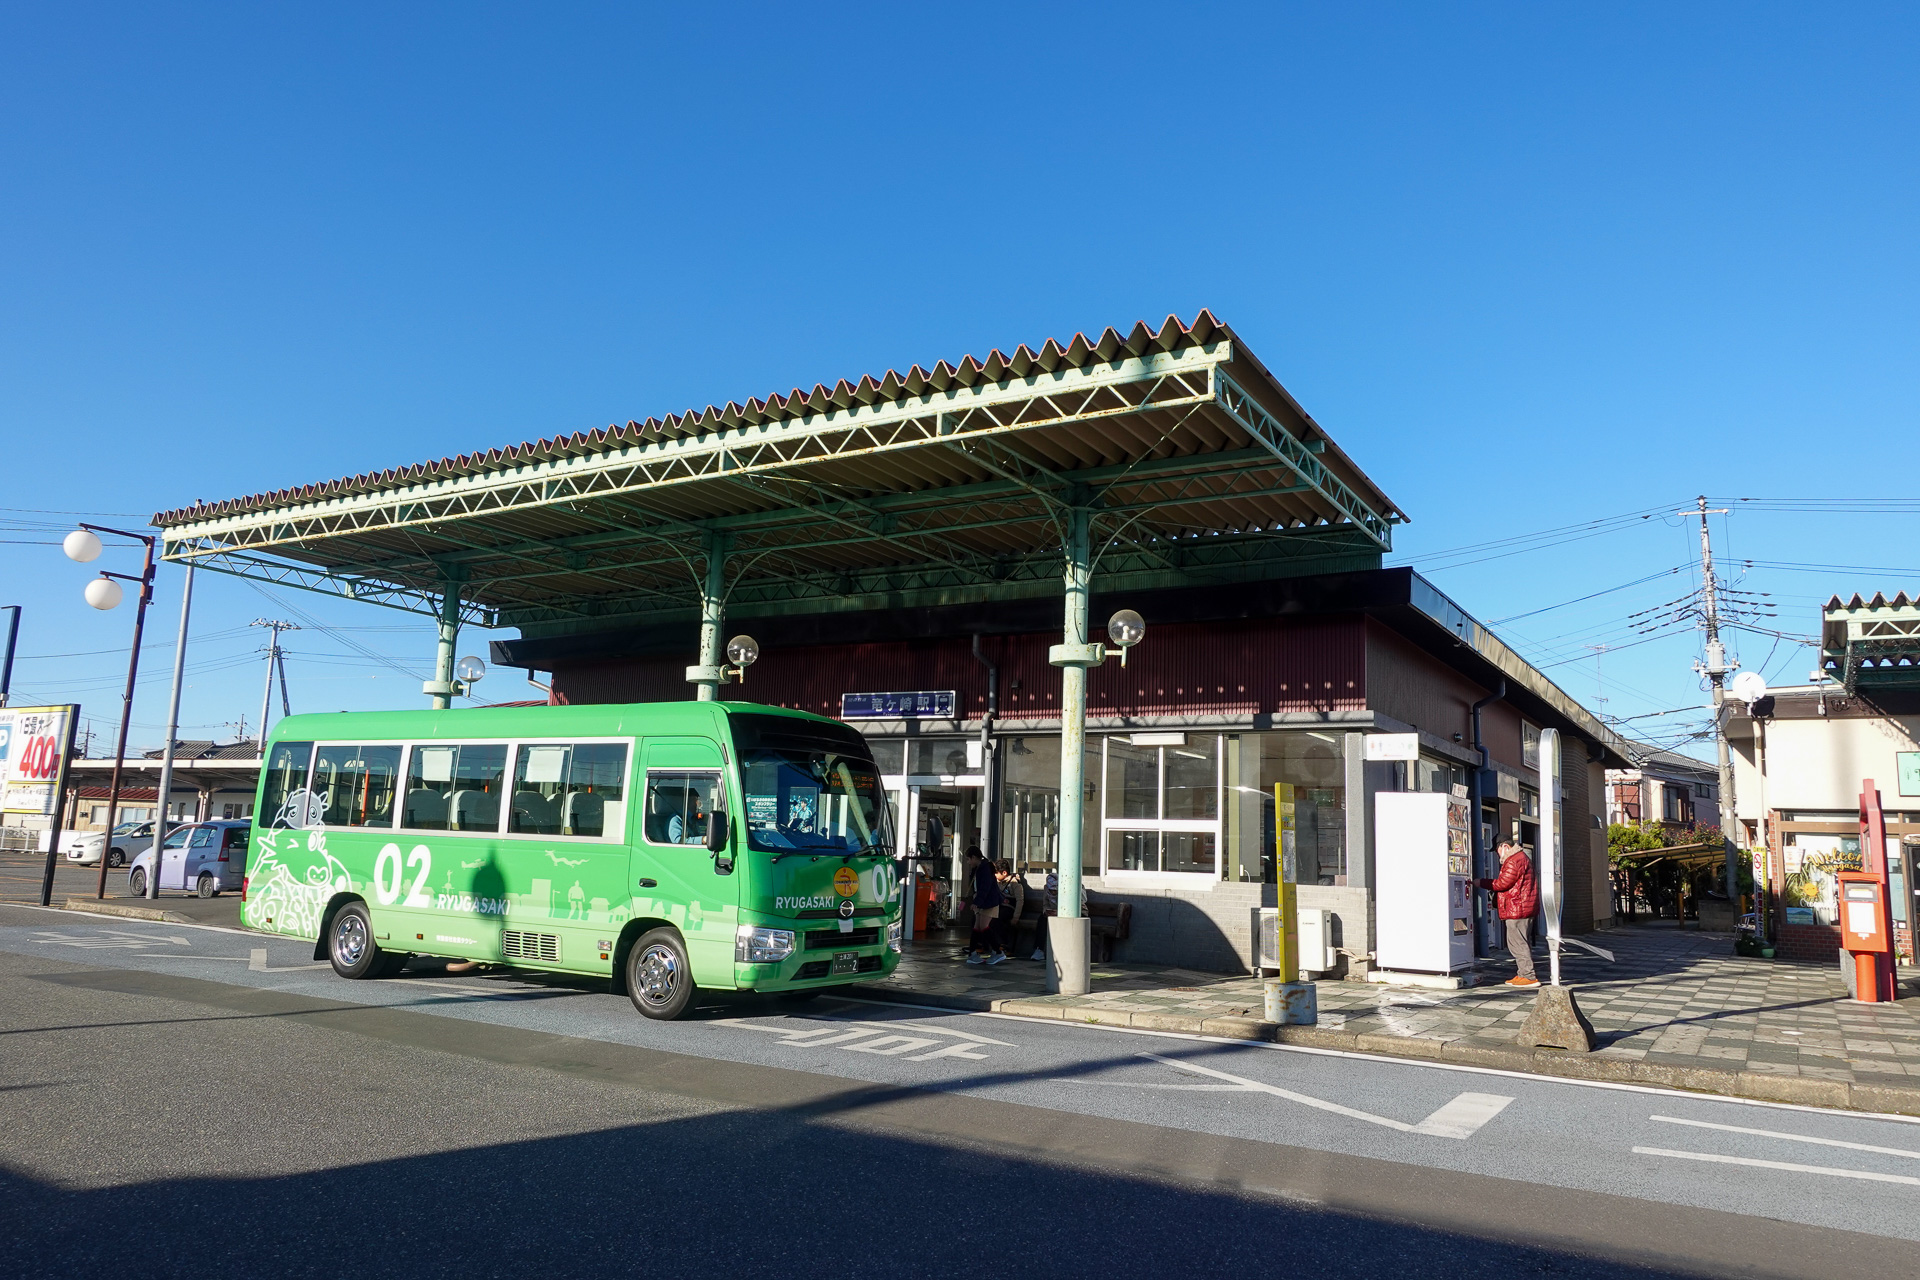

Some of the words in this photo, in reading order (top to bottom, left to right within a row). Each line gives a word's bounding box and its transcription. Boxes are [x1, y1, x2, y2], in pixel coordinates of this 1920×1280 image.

[374, 843, 432, 908] 02
[872, 864, 898, 904] 02
[437, 894, 511, 916] RYUGASAKI
[775, 896, 835, 909] RYUGASAKI
